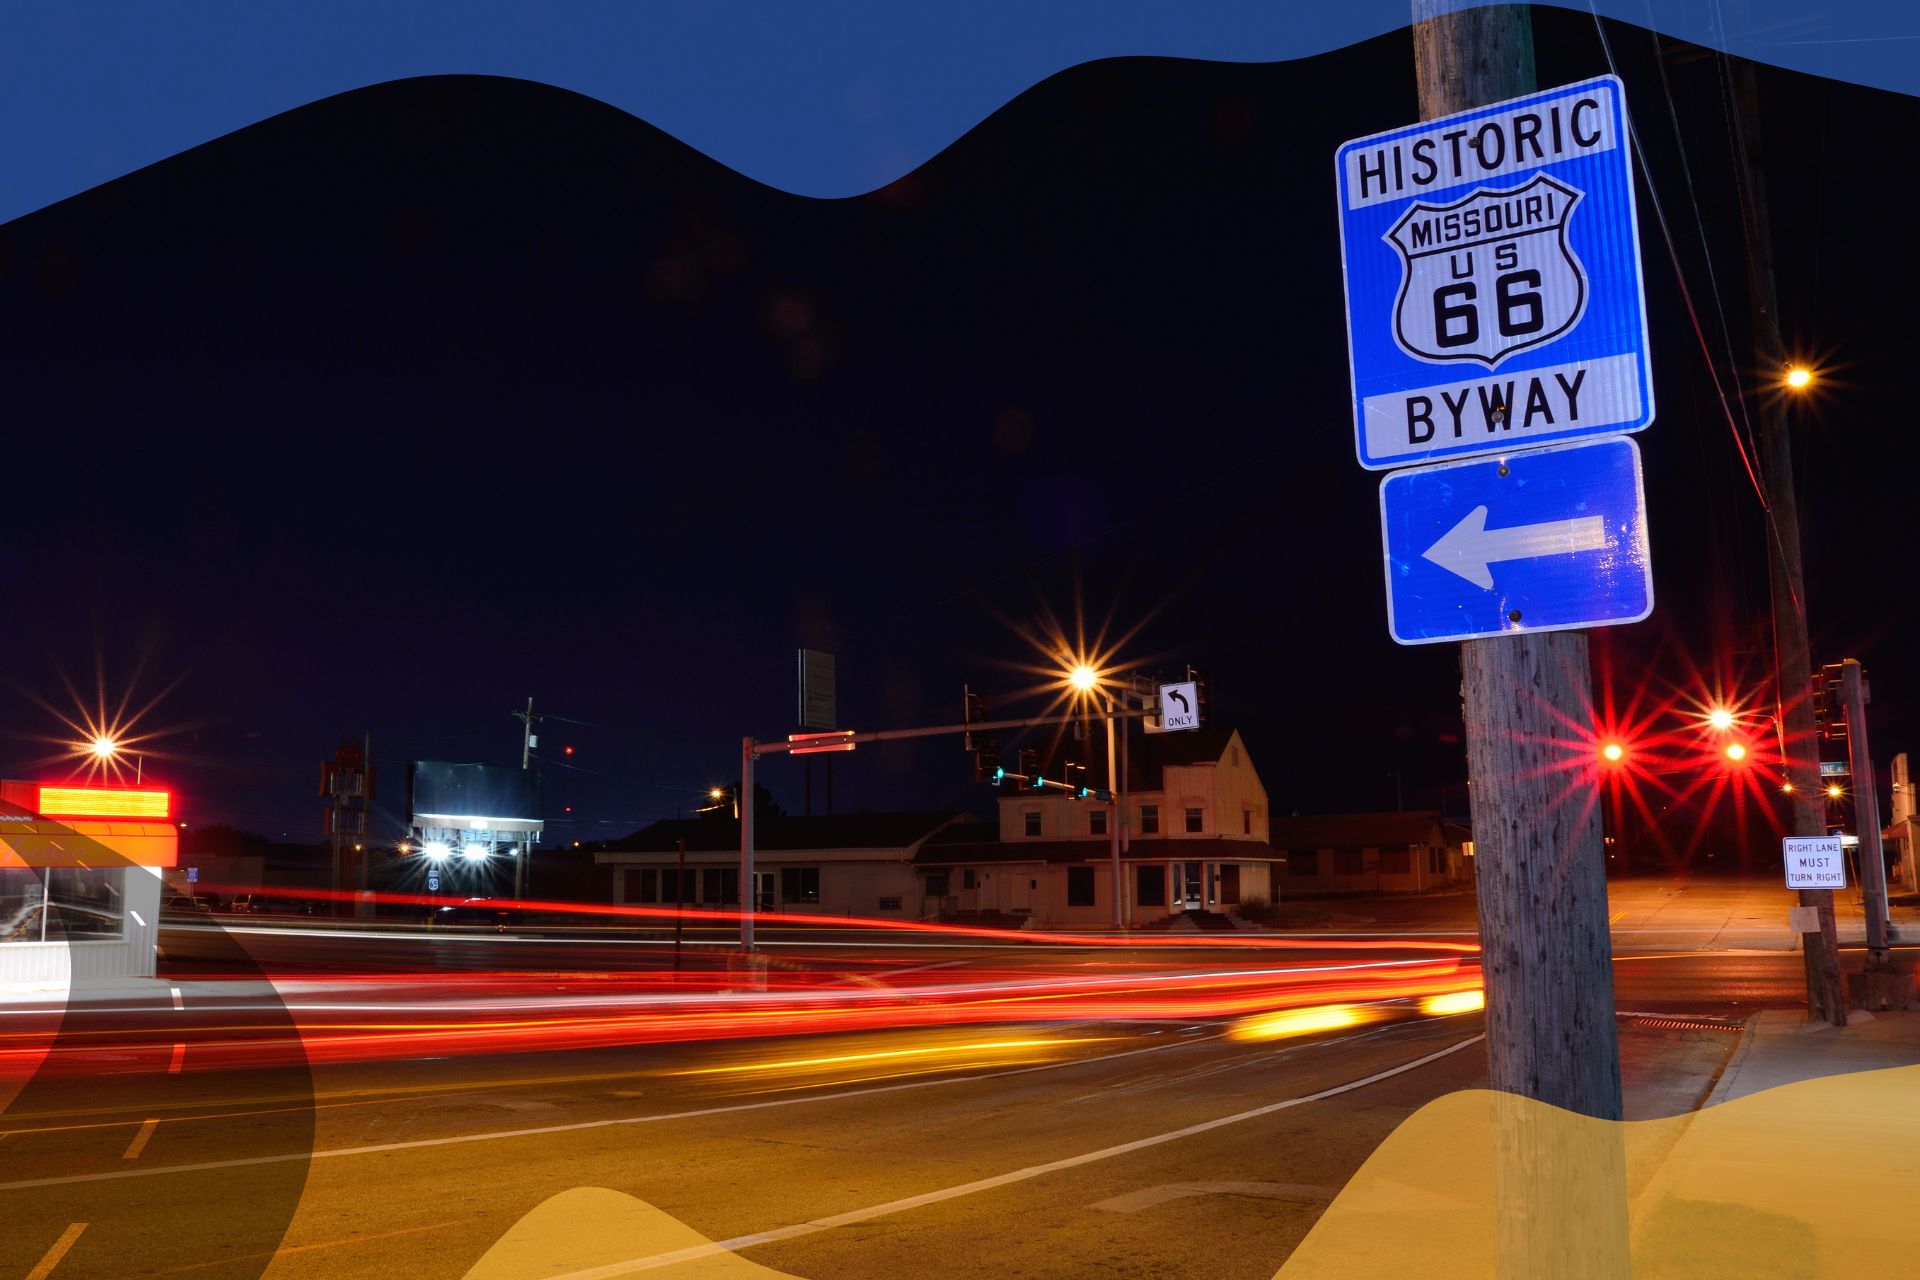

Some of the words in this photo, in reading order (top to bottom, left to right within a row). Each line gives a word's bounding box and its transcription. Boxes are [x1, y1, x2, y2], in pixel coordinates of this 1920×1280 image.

[1359, 98, 1602, 198] HISTORIC
[1411, 193, 1555, 249] MISSOURI
[1433, 268, 1544, 348] 66
[1406, 369, 1587, 444] BYWAY
[1168, 715, 1192, 726] ONLY
[1788, 844, 1812, 853] RIGHT
[1816, 843, 1839, 852] LANE
[1799, 857, 1829, 868] MUST
[1789, 873, 1812, 882] TURN
[1816, 872, 1841, 881] RIGHT
